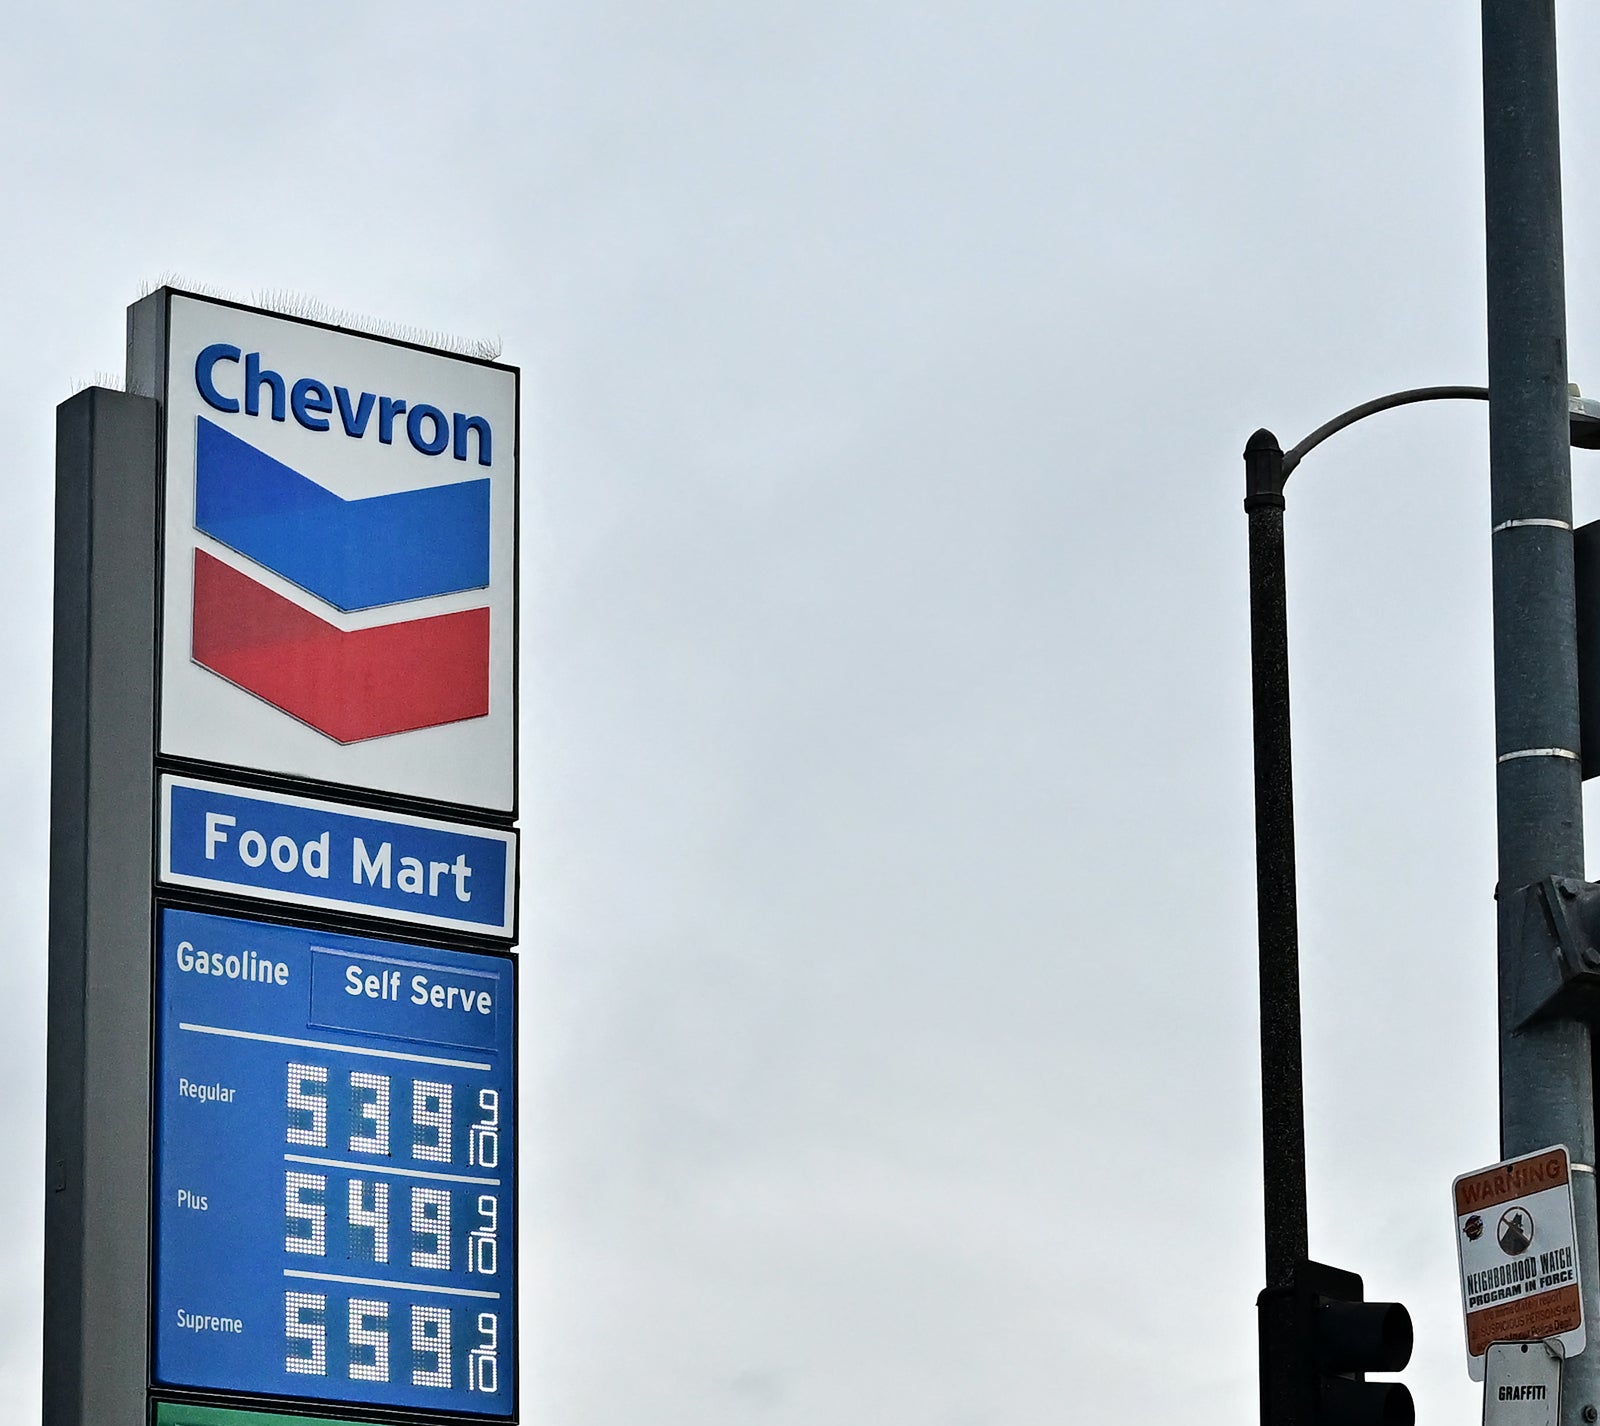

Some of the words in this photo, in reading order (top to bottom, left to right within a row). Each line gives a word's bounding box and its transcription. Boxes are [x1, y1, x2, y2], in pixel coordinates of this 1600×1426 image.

[195, 343, 492, 466] Chevron
[205, 812, 330, 879] Food
[353, 837, 472, 902] Mart
[176, 941, 289, 986] Gasoline
[345, 966, 401, 1001] Self
[410, 975, 492, 1015] Serve
[179, 1079, 236, 1103] Regular
[287, 1062, 452, 1163] 539
[1462, 1159, 1561, 1205] WARNING
[177, 1189, 208, 1211] Plus
[285, 1171, 451, 1270] 549
[1467, 1256, 1536, 1297] NEIGHBORHOOD
[1540, 1246, 1573, 1277] WATCH
[1469, 1282, 1522, 1309] PROGRAM
[1525, 1279, 1537, 1293] IN
[1540, 1269, 1574, 1289] FORCE
[177, 1309, 243, 1334] Supreme
[285, 1291, 452, 1388] 559
[1481, 1315, 1524, 1338] SUSPICIOUS
[1525, 1308, 1562, 1327] PERSONS
[1562, 1303, 1577, 1315] and
[1498, 1385, 1546, 1401] GRAFFITI
